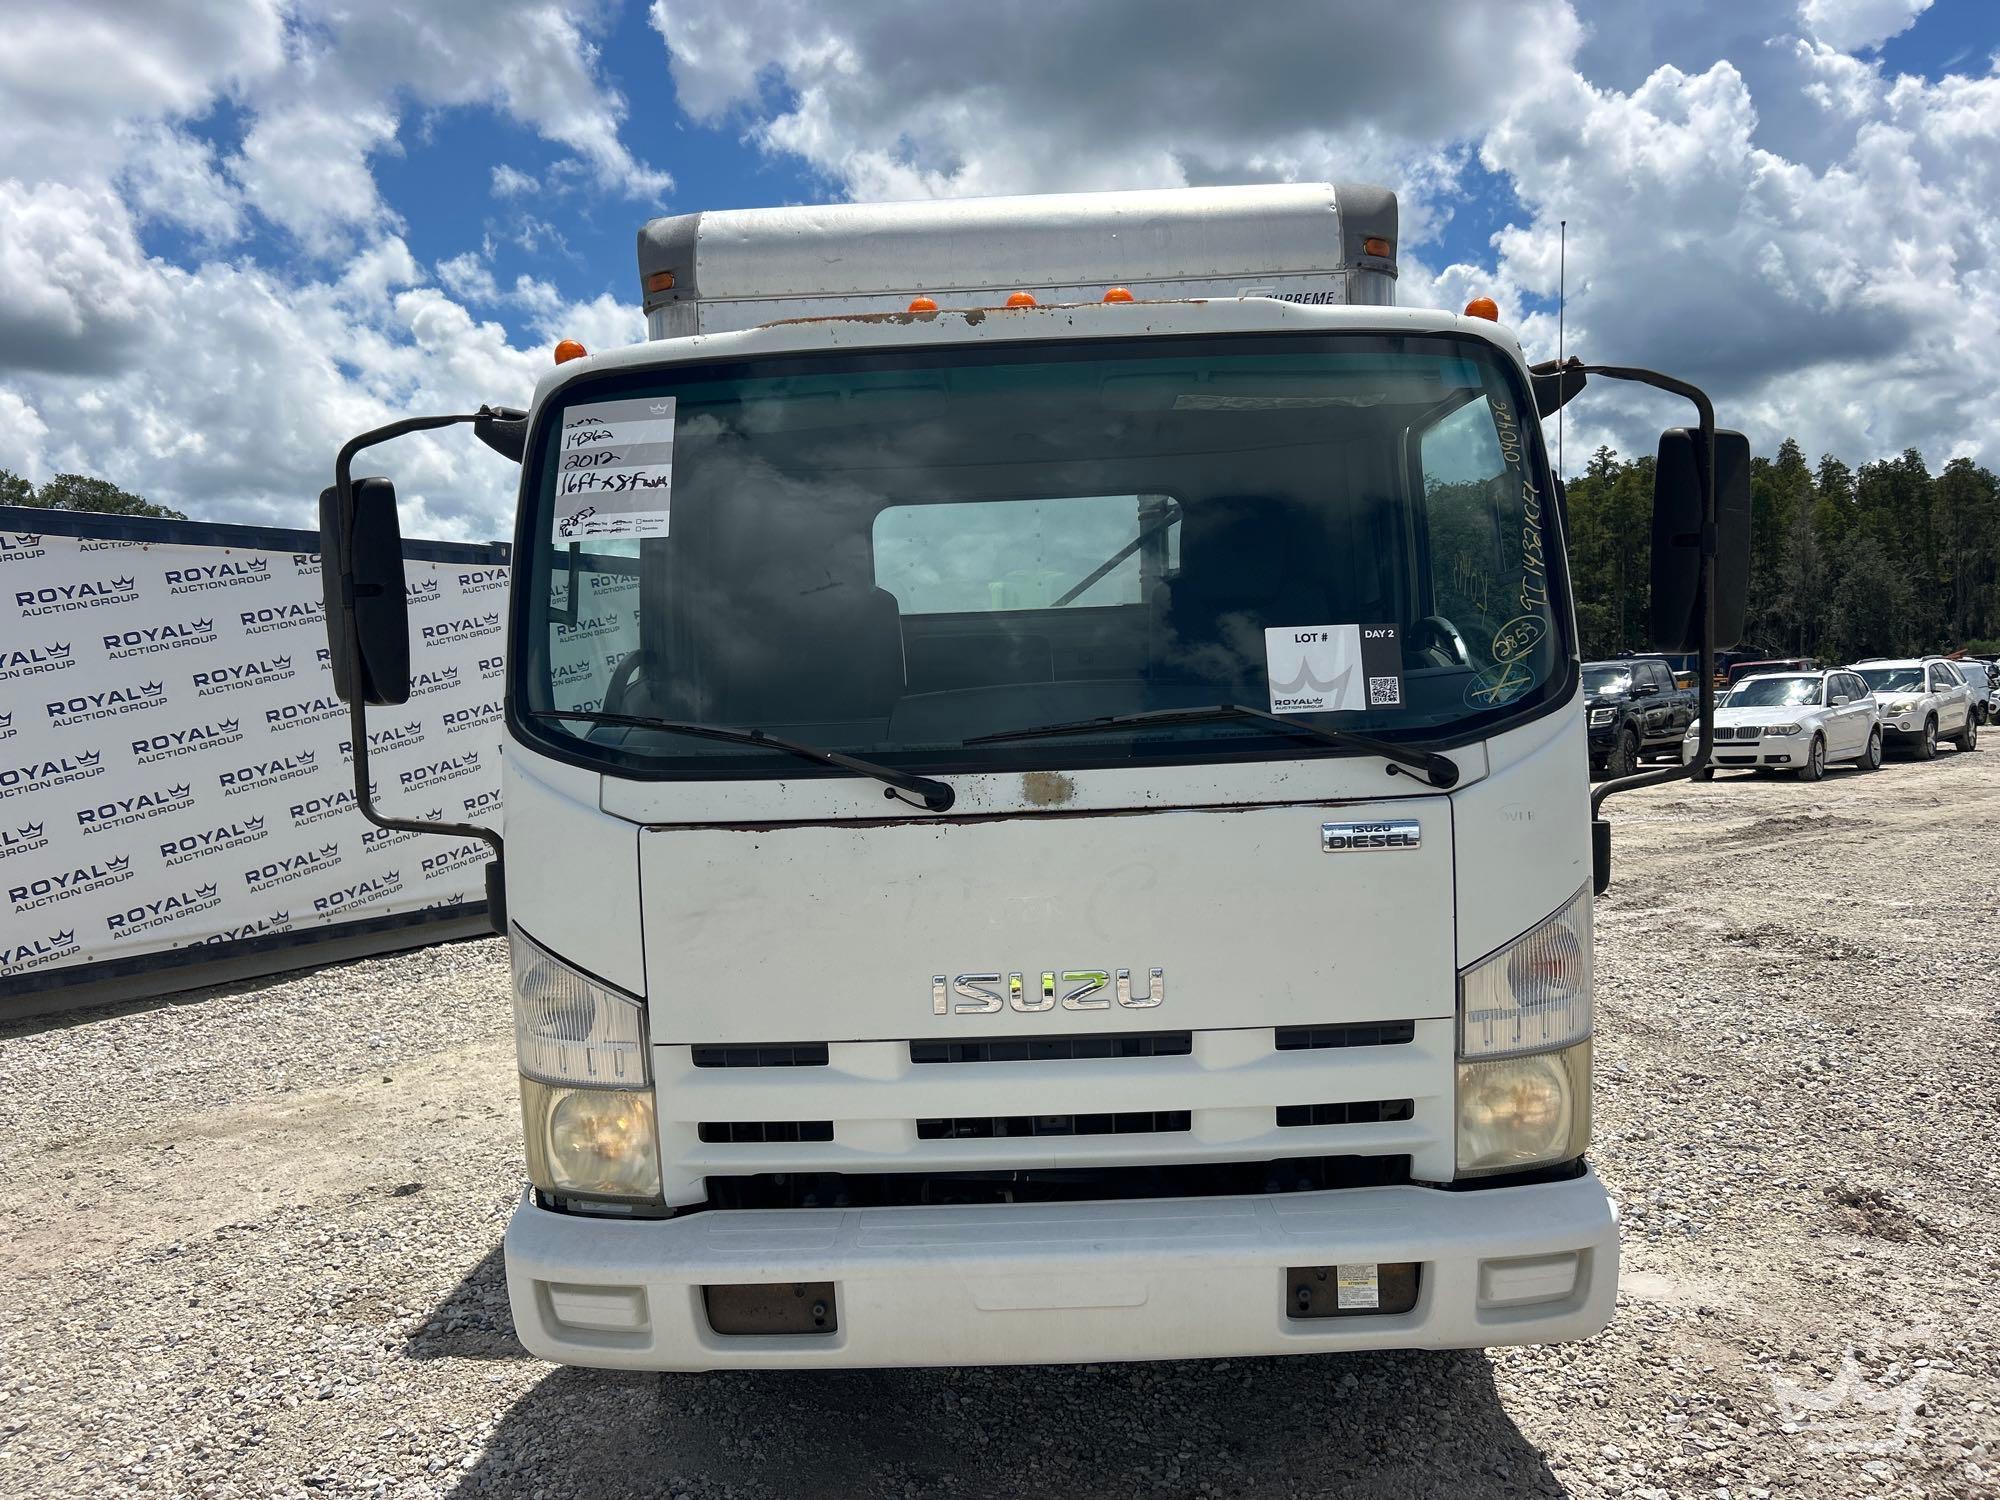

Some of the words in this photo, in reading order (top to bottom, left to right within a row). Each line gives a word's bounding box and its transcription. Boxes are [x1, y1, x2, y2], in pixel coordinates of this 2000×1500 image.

[1265, 291, 1335, 304] PREME
[564, 451, 621, 470] 2012
[165, 562, 248, 584] ROYAL
[170, 581, 227, 595] AUCTION
[230, 574, 271, 586] GROUP
[458, 569, 510, 586] ROYA
[15, 581, 112, 607] ROYAL
[463, 582, 503, 594] AUCTION
[594, 586, 625, 596] AUCTION
[21, 601, 88, 617] AUCTION
[90, 593, 139, 607] GROUP
[240, 602, 316, 626] ROYAL
[103, 624, 193, 649] ROYAL
[245, 621, 297, 635] AUCTION
[299, 615, 326, 626] GROU
[422, 618, 484, 638] ROYAL
[426, 633, 468, 647] AUCTION
[470, 626, 501, 638] GROUP
[560, 632, 593, 643] AUCTION
[595, 626, 620, 636] GROUP
[1295, 632, 1318, 643] LOT
[1321, 632, 1328, 642] #
[1364, 629, 1386, 638] DAY
[1387, 629, 1395, 638] 2
[109, 643, 170, 660] AUCTION
[172, 634, 217, 649] GROUP
[23, 660, 75, 676] GROUP
[192, 661, 273, 687] ROYAL
[566, 673, 592, 683] GROUP
[198, 681, 253, 697] AUCTION
[255, 671, 295, 686] GROUP
[428, 680, 461, 693] GROUP
[47, 688, 141, 717] ROYAL
[53, 709, 116, 728] AUCTION
[120, 698, 168, 713] GROUP
[265, 697, 339, 723] ROYAL
[443, 702, 503, 725] ROYAL
[1274, 698, 1313, 706] ROYAL
[270, 715, 320, 733] AUCTION
[322, 709, 351, 720] GROU
[447, 718, 488, 734] AUCTION
[132, 725, 219, 755] ROYAL
[137, 745, 197, 765] AUCTION
[200, 734, 243, 750] GROUP
[339, 728, 405, 754] RYAL
[391, 735, 425, 749] GROUP
[0, 759, 77, 787] OYAL
[54, 767, 105, 786] GROUP
[219, 758, 297, 787] ROYAL
[225, 777, 278, 797] AUCTION
[280, 765, 319, 781] GROUP
[400, 758, 463, 784] ROYAL
[404, 776, 446, 793] AUCTION
[449, 765, 481, 779] GROUP
[77, 791, 169, 825] ROYAL
[83, 813, 145, 835] AUCTION
[148, 799, 195, 817] GROUP
[294, 807, 343, 828] AUCTION
[160, 824, 245, 857] ROYAL
[1328, 834, 1417, 849] DIESEL
[1352, 825, 1391, 833] ISUZU
[166, 845, 223, 868] AUCTION
[226, 830, 268, 849] GROUP
[366, 833, 410, 854] AUCTION
[245, 851, 321, 884] ROYAL
[422, 841, 483, 872] ROYAL
[425, 858, 467, 880] AUCTION
[469, 849, 495, 866] GROU
[8, 865, 107, 903] ROYAL
[250, 871, 301, 894] AUCTION
[304, 858, 341, 876] GROUP
[15, 888, 81, 913] AUCTION
[85, 871, 134, 892] GROUP
[314, 879, 383, 912] ROYAL
[318, 897, 366, 920] AUCTION
[368, 883, 403, 902] GROUP
[107, 892, 196, 930] ROYAL
[113, 915, 173, 940] AUCTION
[176, 898, 222, 919] GROUP
[27, 945, 81, 968] GROUP
[932, 967, 1165, 1015] ISUZU
